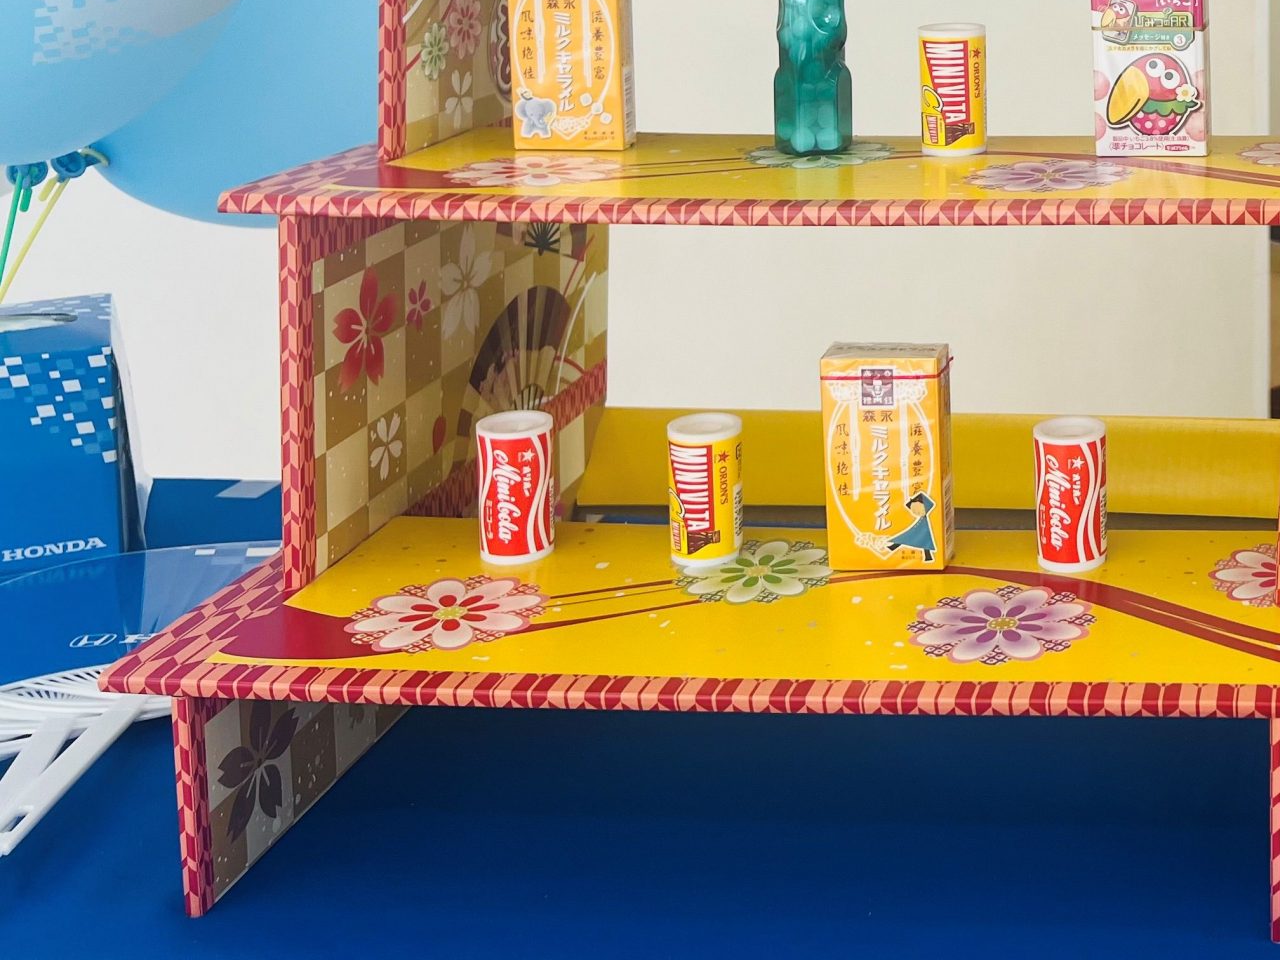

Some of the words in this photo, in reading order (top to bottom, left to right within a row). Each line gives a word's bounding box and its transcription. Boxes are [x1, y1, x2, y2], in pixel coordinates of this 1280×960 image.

[553, 11, 576, 113] ミルクキャラメル
[925, 42, 967, 123] MINIVITA
[862, 411, 893, 423] 森永
[670, 444, 708, 531] MINIVITA
[871, 424, 893, 530] ミルクキャラメル
[1, 536, 107, 562] HONDA
